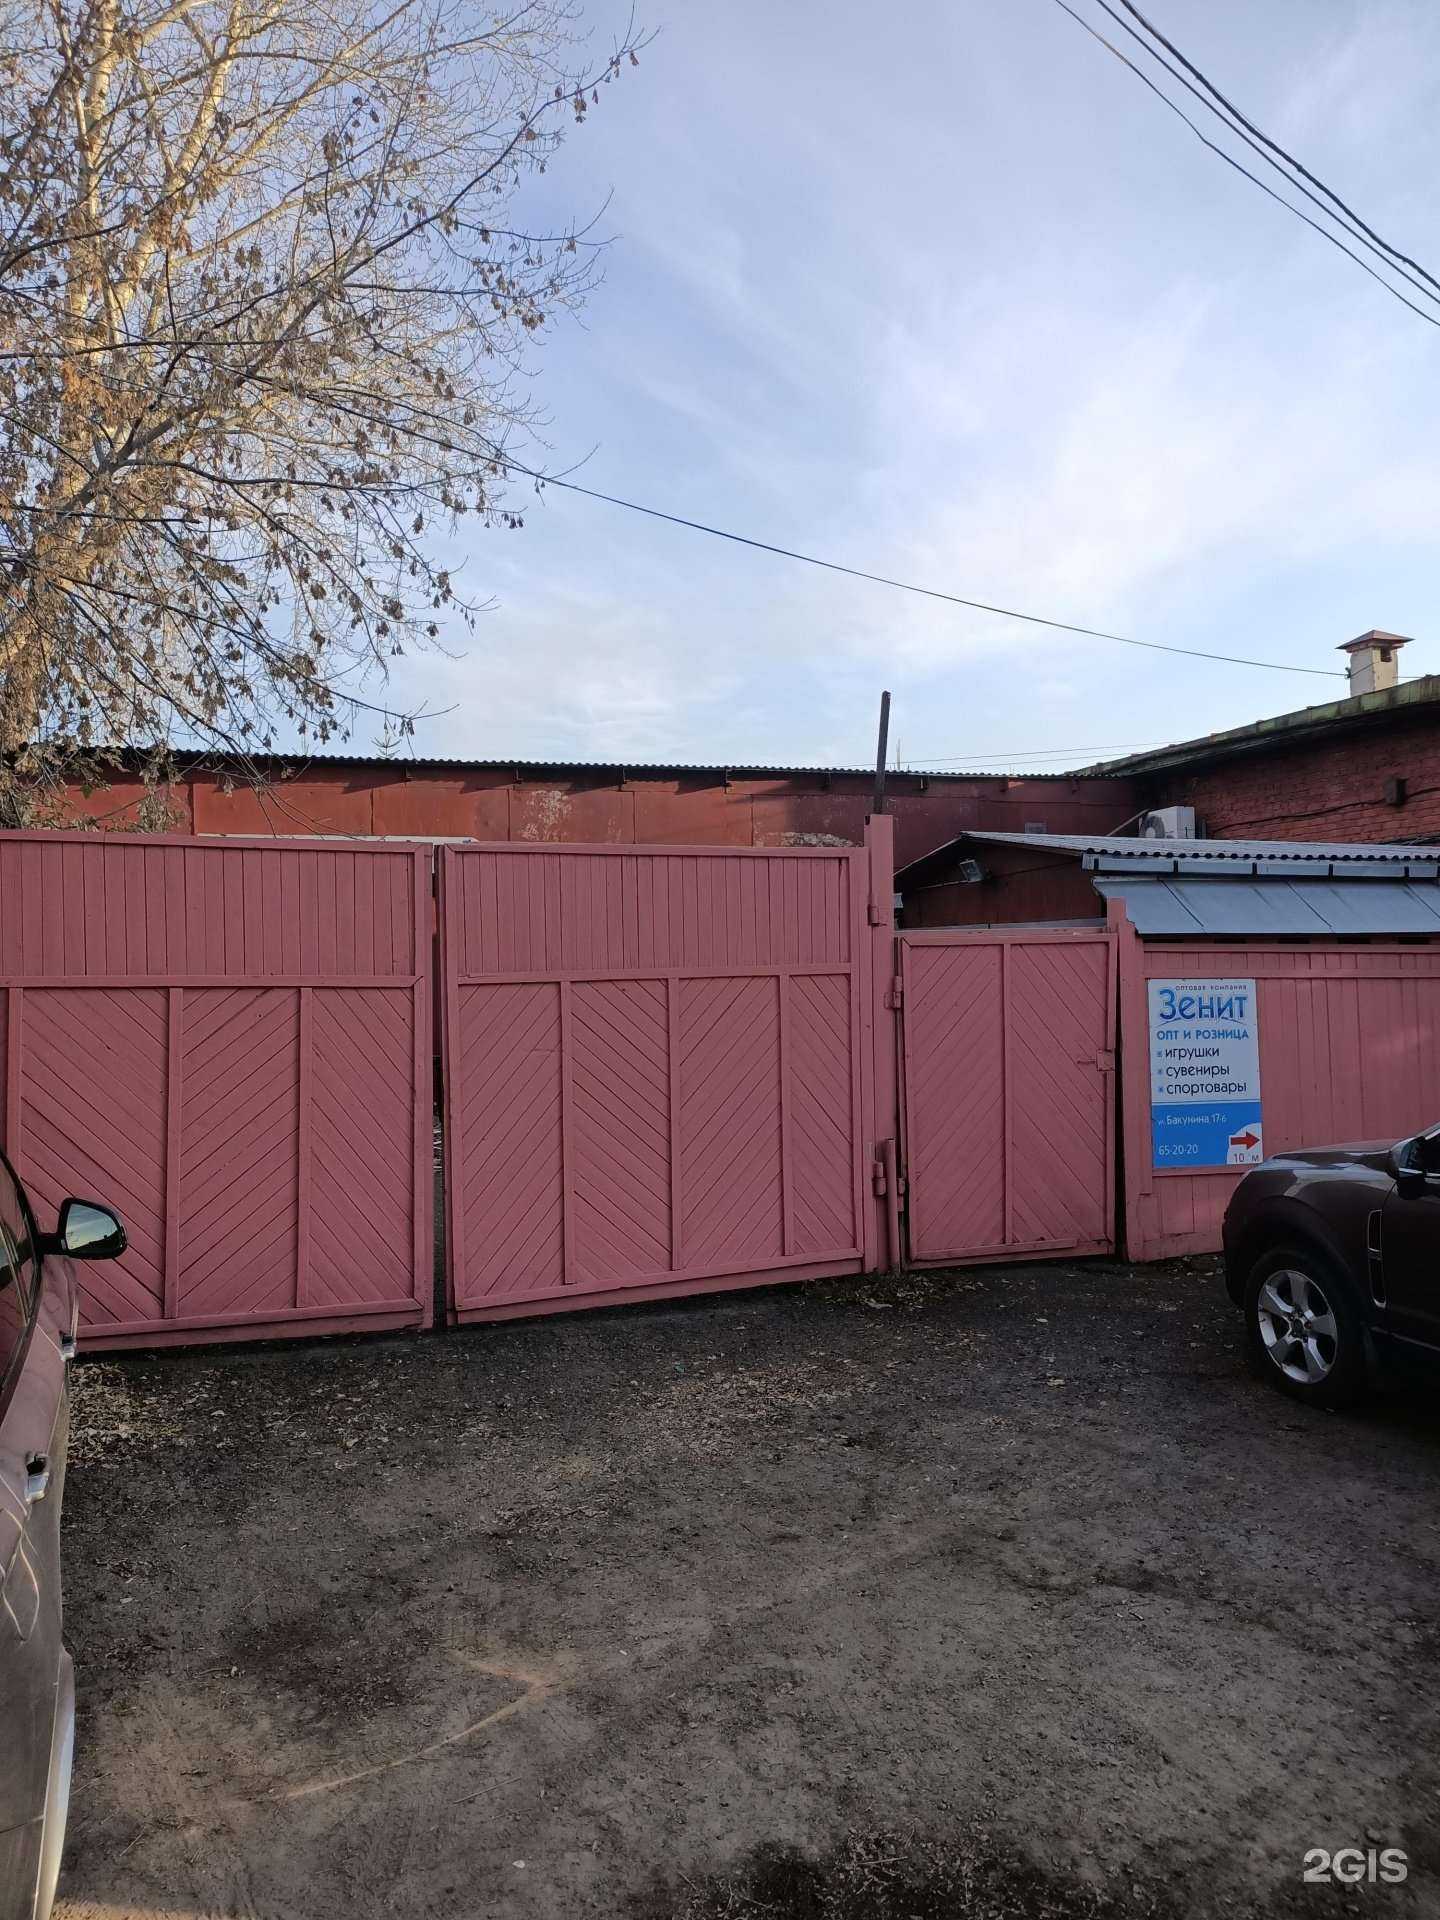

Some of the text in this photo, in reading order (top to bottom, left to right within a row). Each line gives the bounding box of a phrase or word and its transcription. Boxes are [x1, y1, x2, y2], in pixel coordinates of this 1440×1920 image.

[1160, 989, 1248, 1020] Зенит
[1157, 1029, 1249, 1040] ОПТ И РОЗНИЦА
[1165, 1048, 1220, 1060] игрушки
[1166, 1066, 1230, 1078] сувениры
[1167, 1082, 1247, 1096] спортовары
[1234, 1153, 1245, 1163] 10
